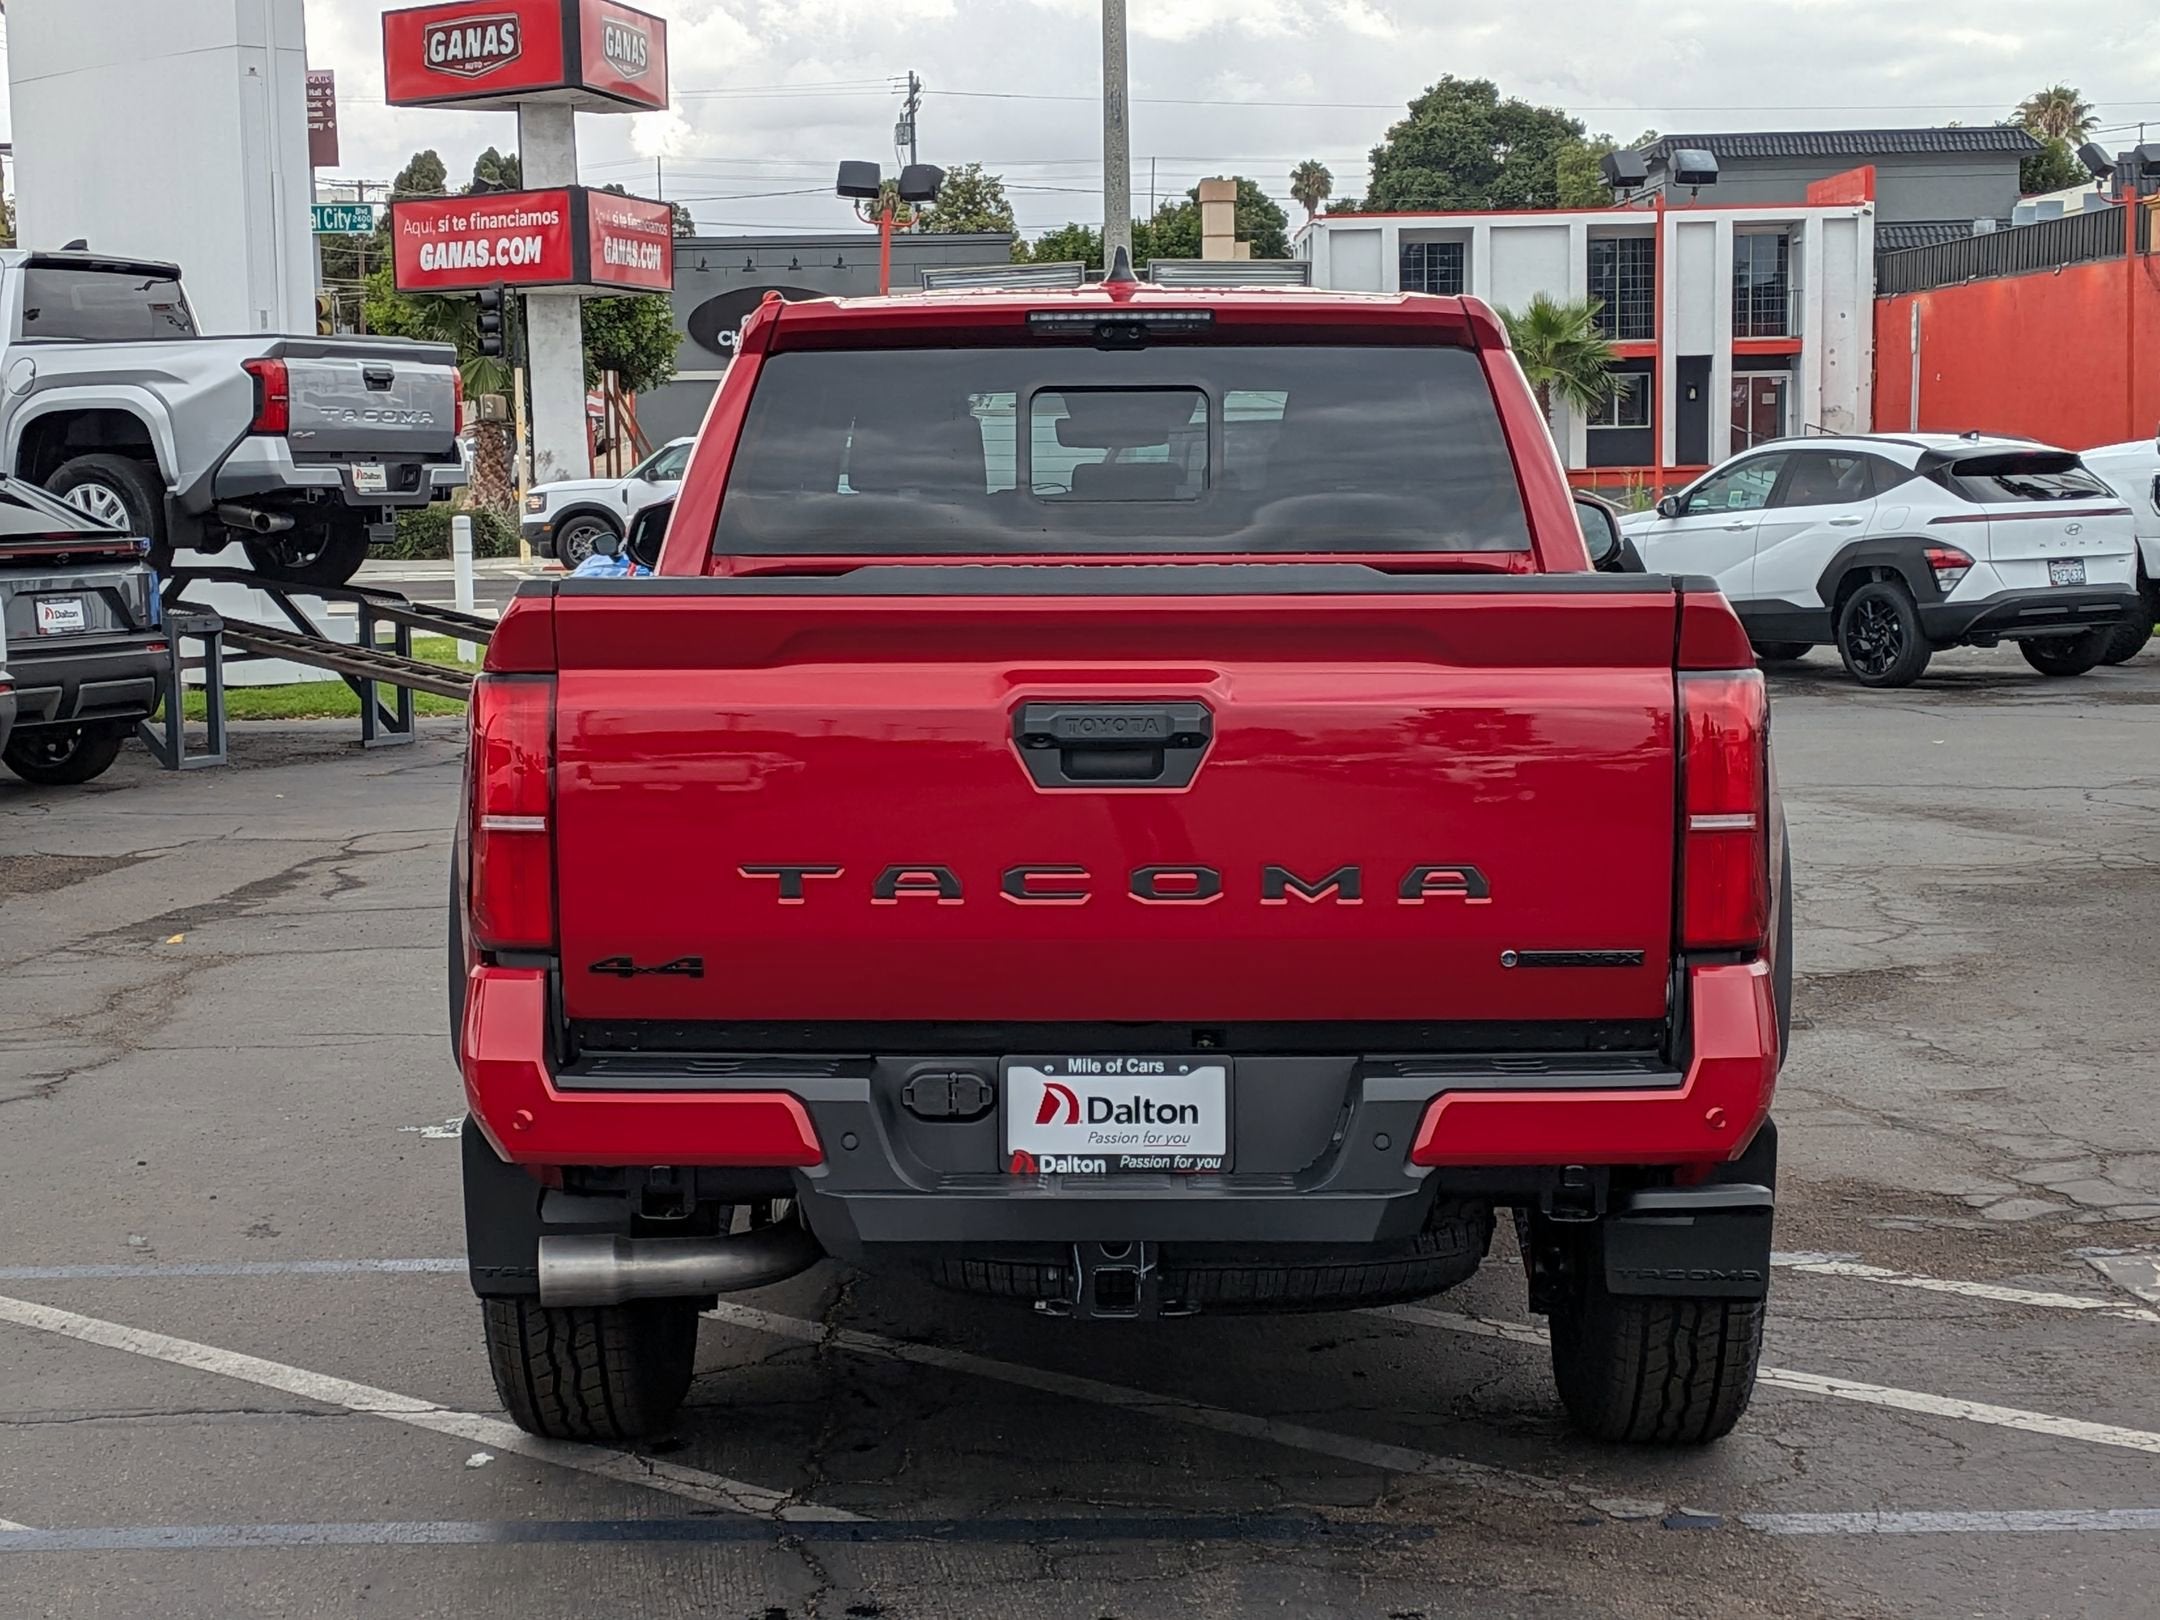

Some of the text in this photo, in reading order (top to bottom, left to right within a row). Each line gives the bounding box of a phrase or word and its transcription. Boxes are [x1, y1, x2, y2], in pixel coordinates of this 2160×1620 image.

[429, 22, 516, 63] GANAS
[605, 26, 647, 67] GANAS
[464, 61, 483, 70] AUTO
[323, 207, 352, 231] City
[437, 217, 450, 233] sí
[451, 215, 468, 231] te
[470, 208, 560, 231] financiamos
[419, 236, 543, 272] GANAS.COM
[603, 236, 662, 271] GANAS.COM
[320, 408, 435, 424] TACOMA
[1065, 717, 1160, 733] TOYOTA
[736, 863, 1493, 906] TACOMA
[1068, 1058, 1165, 1073] Mile of Cars
[1087, 1096, 1199, 1125] Dalton
[1087, 1131, 1191, 1146] Passion for you
[1039, 1155, 1222, 1174] Dalton Passion for you
[1613, 1267, 1762, 1281] TACOMA
